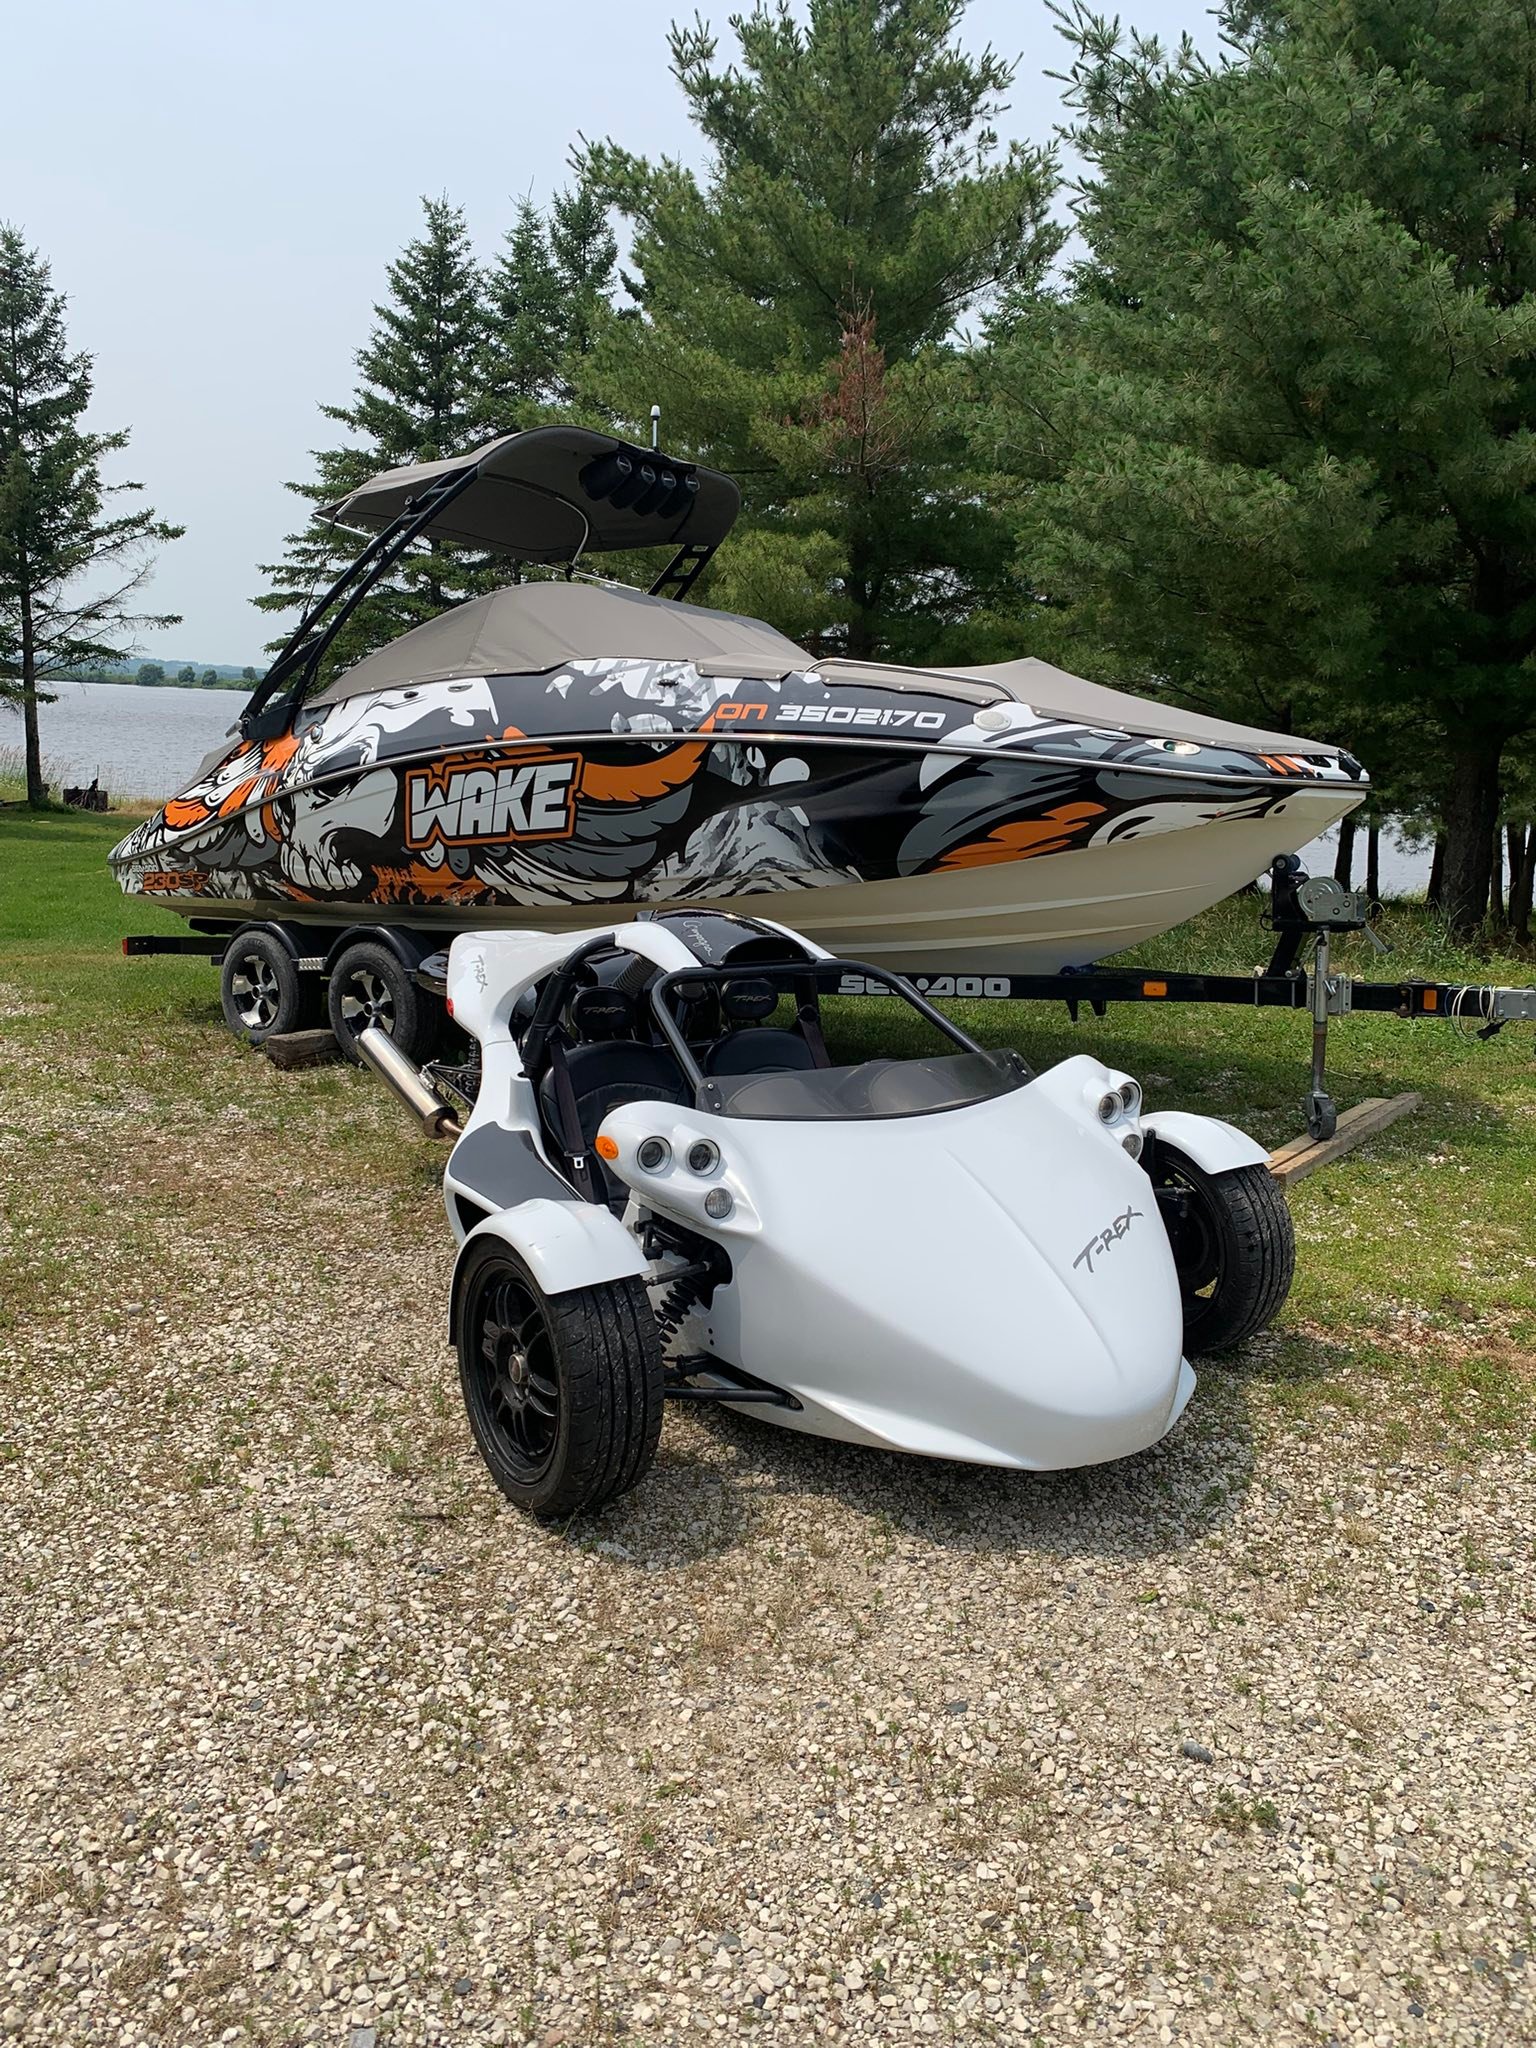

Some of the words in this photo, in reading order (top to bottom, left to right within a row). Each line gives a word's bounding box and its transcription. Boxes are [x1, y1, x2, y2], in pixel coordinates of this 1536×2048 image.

[774, 703, 947, 729] 3502170
[411, 761, 574, 840] WAKE
[1072, 1204, 1145, 1274] T-REX
